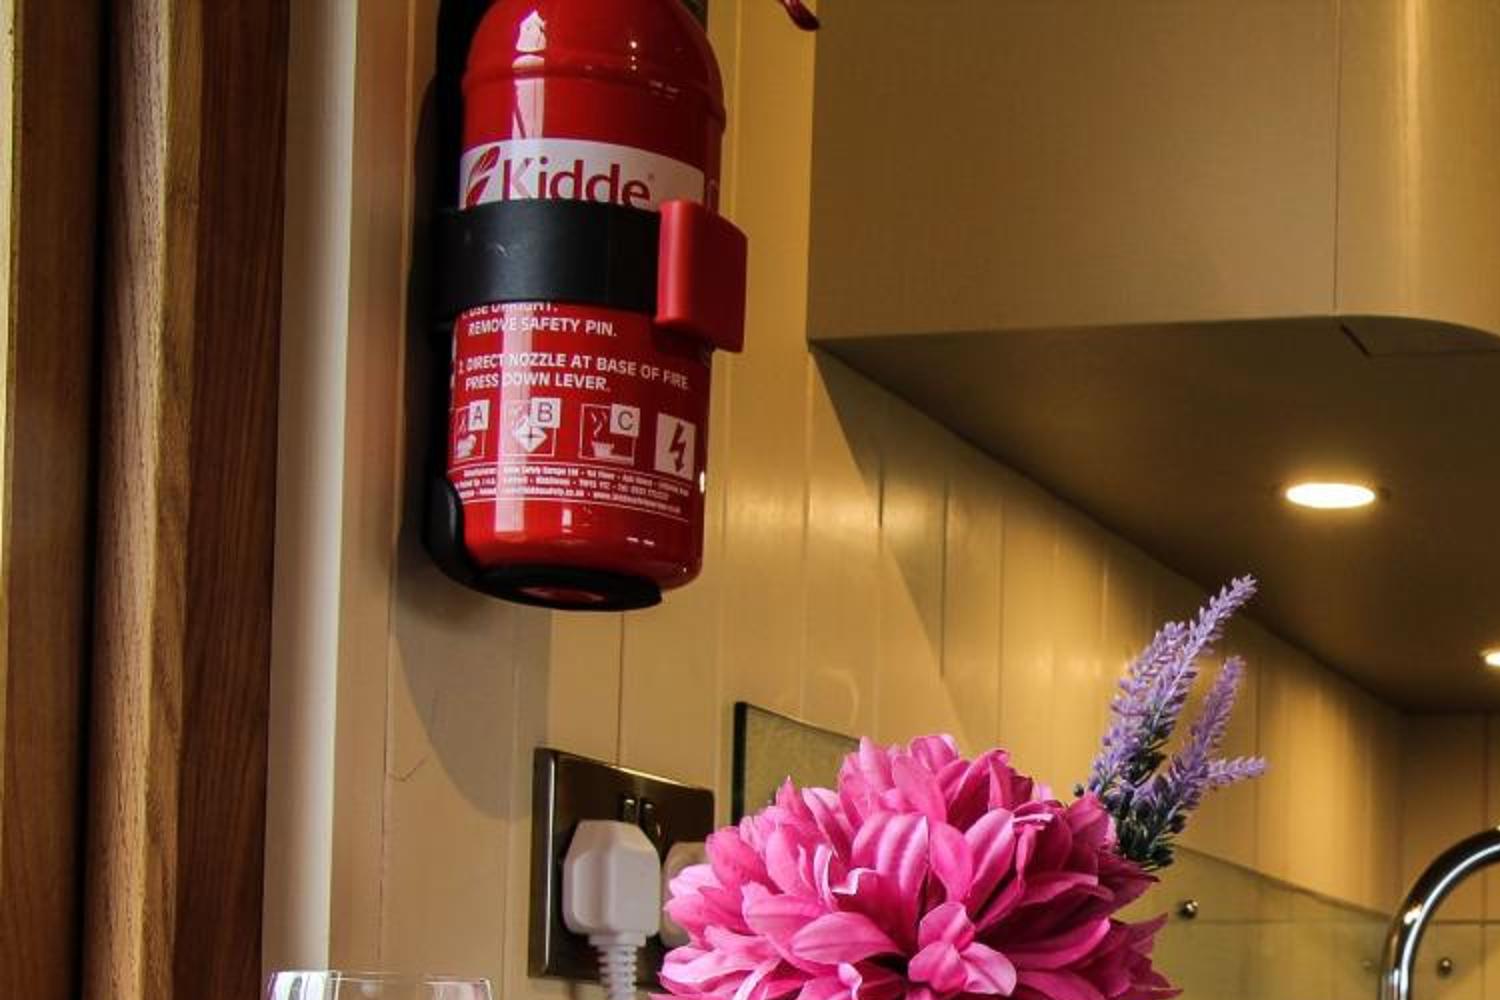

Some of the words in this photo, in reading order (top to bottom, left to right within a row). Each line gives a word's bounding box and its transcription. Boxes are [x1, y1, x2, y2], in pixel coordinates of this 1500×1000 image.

[502, 155, 651, 207] Kidde
[468, 317, 517, 336] REMOVE
[520, 316, 581, 333] SAFETY
[585, 319, 617, 337] PIN.
[466, 354, 505, 371] DIRECT
[508, 353, 567, 367] NOZZLE
[570, 354, 592, 369] AT
[596, 357, 638, 377] BASE
[640, 364, 660, 381] OF
[465, 374, 499, 391] PRESS
[503, 371, 551, 386] DOWN
[555, 373, 611, 391] LEVER.
[473, 405, 483, 425] A
[537, 401, 553, 423] B
[617, 410, 633, 431] C
